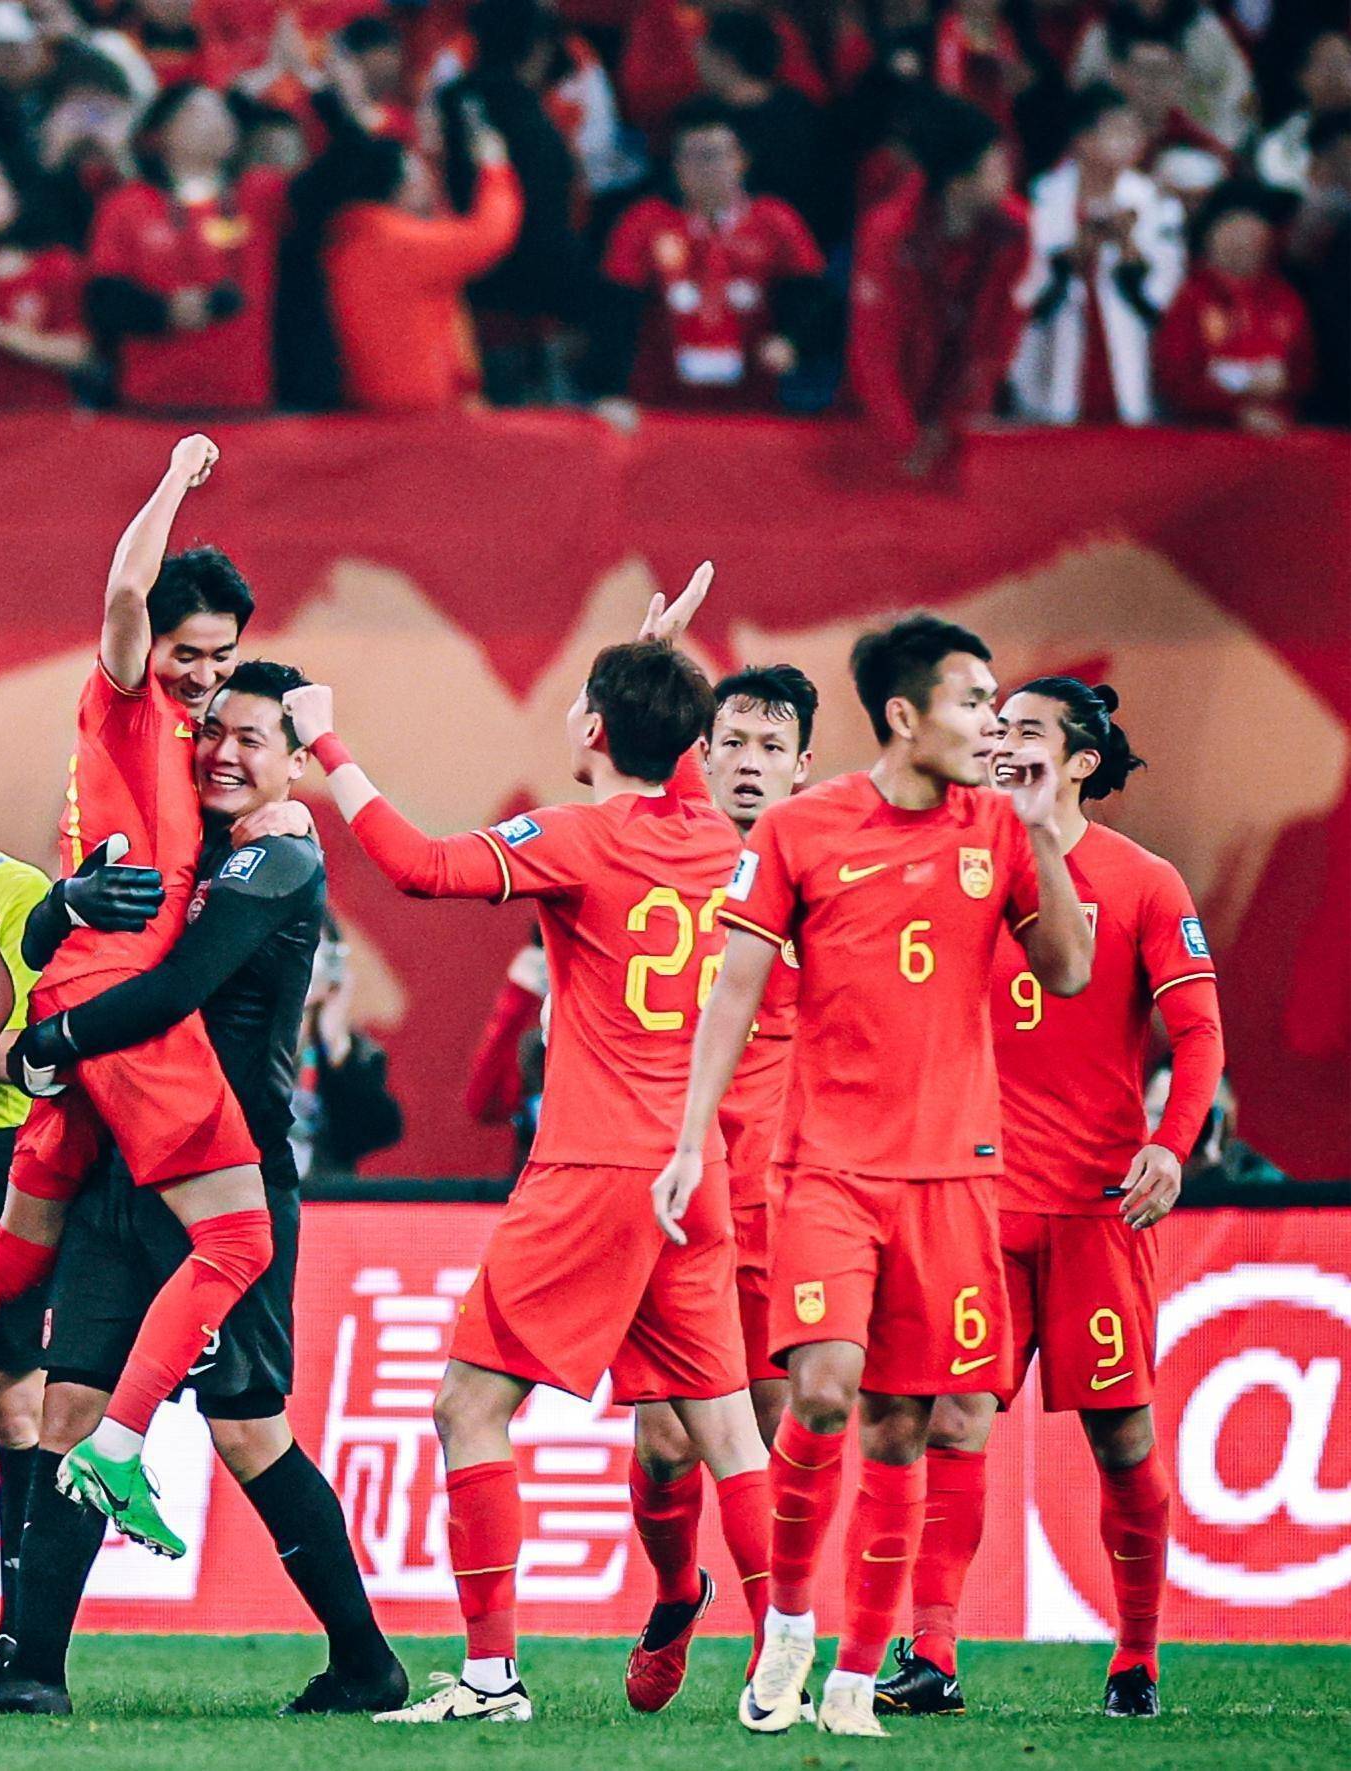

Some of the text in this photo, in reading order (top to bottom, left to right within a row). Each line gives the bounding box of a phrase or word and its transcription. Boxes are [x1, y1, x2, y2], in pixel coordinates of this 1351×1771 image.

[899, 920, 935, 984] 6
[1010, 971, 1042, 1030] 9
[954, 1286, 987, 1349] 6
[1089, 1308, 1124, 1367] 9
